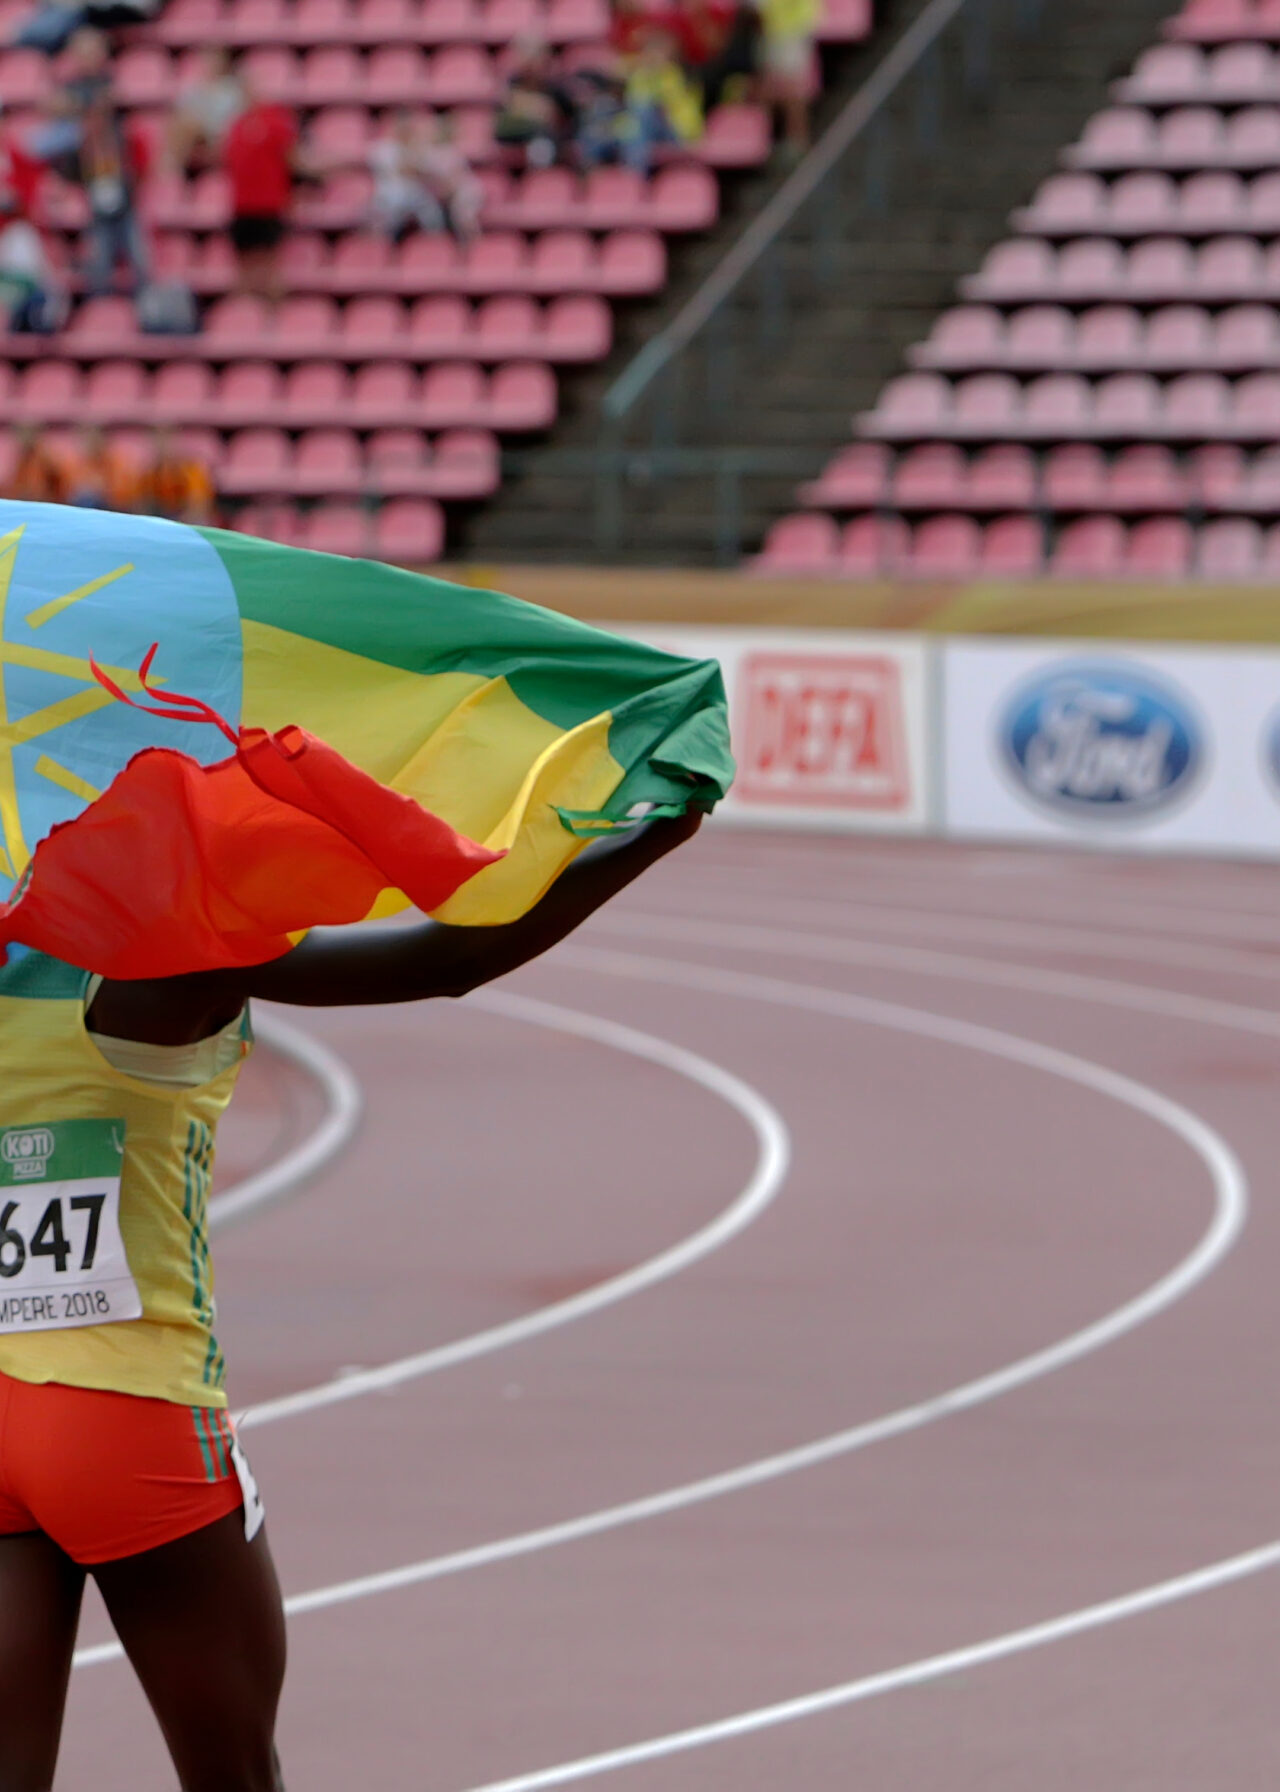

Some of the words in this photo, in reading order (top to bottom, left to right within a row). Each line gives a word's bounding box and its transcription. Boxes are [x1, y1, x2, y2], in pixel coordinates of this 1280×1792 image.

[1023, 679, 1176, 799] Ford
[6, 1133, 49, 1158] KOTI
[61, 1290, 110, 1317] 2018
